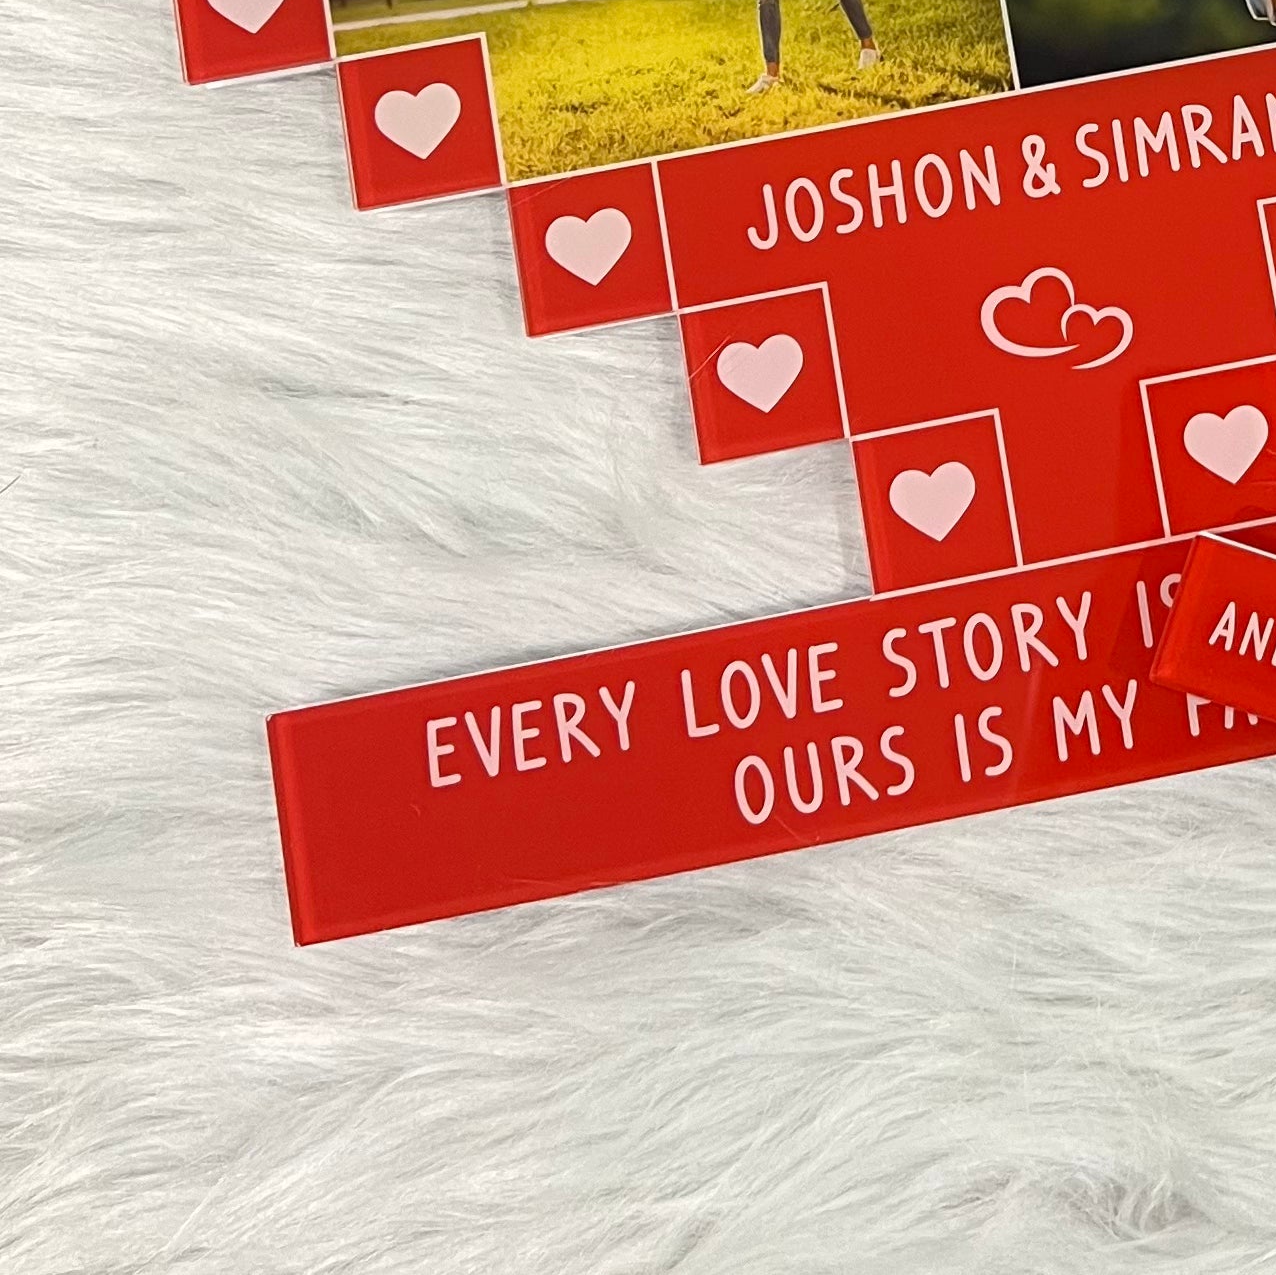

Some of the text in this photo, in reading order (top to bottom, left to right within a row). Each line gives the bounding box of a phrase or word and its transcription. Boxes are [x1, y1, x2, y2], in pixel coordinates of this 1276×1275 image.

[747, 145, 1001, 250] JOSHON
[1021, 134, 1062, 199] &
[426, 680, 636, 788] EVERY
[680, 642, 844, 738] LOVE
[882, 591, 1092, 698] STORY
[734, 725, 915, 825] OURS
[954, 706, 1013, 783] IS
[1052, 679, 1138, 762] MY
